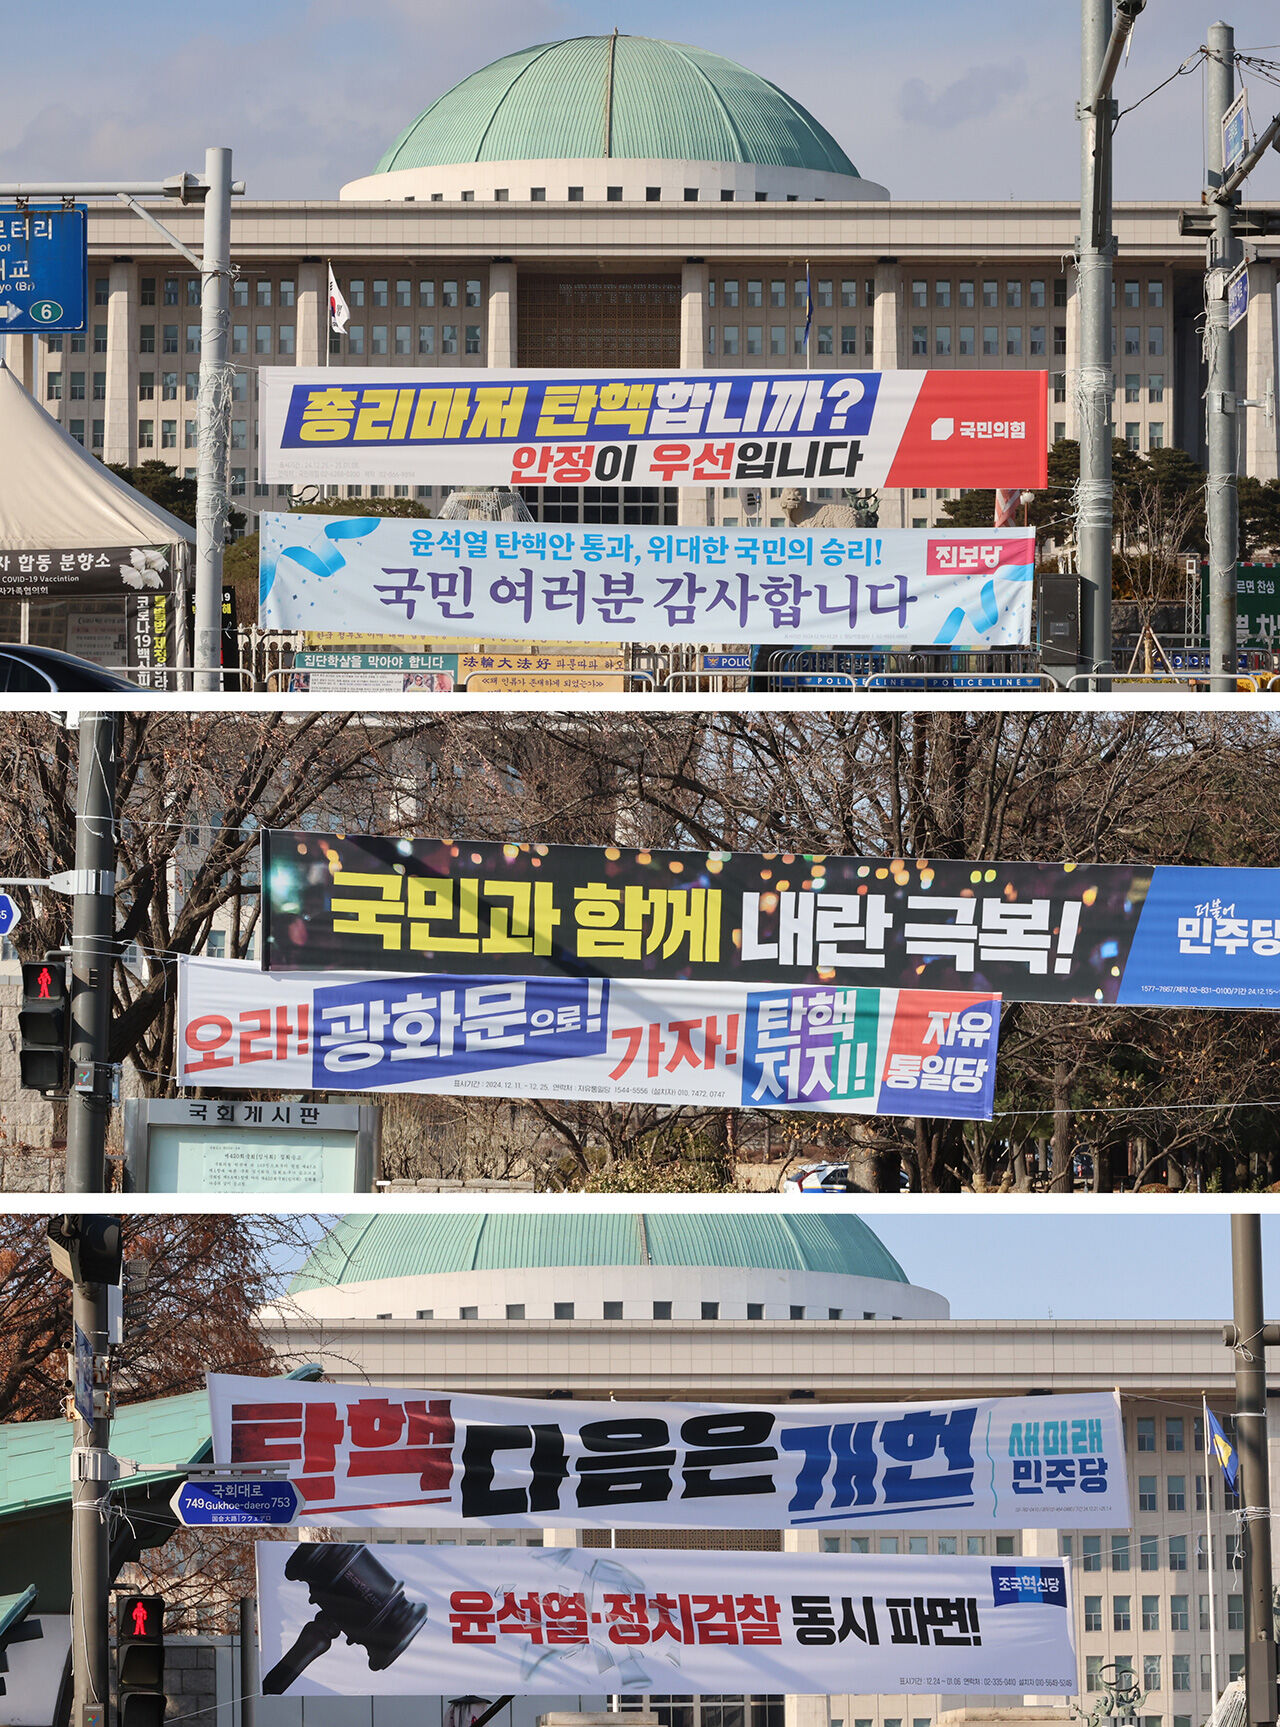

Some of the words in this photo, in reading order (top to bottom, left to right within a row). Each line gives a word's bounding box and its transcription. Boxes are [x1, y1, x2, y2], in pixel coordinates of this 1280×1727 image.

[15, 281, 36, 291] (Br)
[41, 304, 52, 320] 6
[299, 386, 529, 441] 총리마저
[535, 378, 865, 437] 탄핵합니까?
[959, 421, 1026, 439] 국민의힘
[511, 444, 638, 483] 안정이
[649, 440, 864, 481] 우선입니다
[409, 529, 488, 558] 윤석열
[495, 531, 575, 561] 탄핵안
[580, 533, 641, 566] 통과,
[647, 535, 730, 564] 위대한
[734, 537, 813, 566] 국민의
[820, 538, 882, 567] 승리!
[935, 545, 1003, 569] 진보당
[18, 554, 52, 572] 합동
[59, 553, 111, 571] 분향소
[373, 566, 474, 620] 국민
[489, 567, 644, 625] 여러분
[653, 571, 918, 629] 감사합니다
[1257, 580, 1275, 594] 찬성
[304, 655, 362, 668] 집단학살을
[368, 655, 403, 668] 막아야
[409, 655, 444, 668] 합니다
[463, 656, 552, 669] 法輪大法好
[876, 677, 905, 686] LINE
[933, 678, 983, 686] POLICE
[991, 678, 1022, 686] LINE
[1194, 898, 1235, 920] 더불어
[331, 872, 561, 956] 국민과
[574, 882, 722, 962] 함께
[741, 891, 893, 968] 내란
[904, 895, 1082, 974] 극복!
[1177, 917, 1280, 956] 민주당
[184, 1003, 310, 1074] 오라!
[320, 978, 603, 1073] 광화문으로!
[608, 1013, 740, 1081] 가자!
[757, 989, 857, 1049] 탄핵
[922, 1011, 993, 1048] 자유
[454, 1080, 480, 1088] 표시기간
[751, 1042, 868, 1102] 저지!
[886, 1053, 989, 1093] 통일당
[189, 1103, 320, 1125] 국회게시판
[1008, 1418, 1104, 1457] 새미래
[231, 1398, 456, 1501] 탄핵
[461, 1411, 779, 1518] 다음은
[780, 1407, 978, 1512] 개헌
[1012, 1457, 1108, 1494] 민주당
[212, 1484, 264, 1498] 국회대로
[185, 1498, 205, 1509] 749
[205, 1501, 271, 1511] Gukhoe-daero
[270, 1497, 291, 1508] 753
[998, 1575, 1060, 1594] 조국혁신당
[791, 1595, 880, 1646] 동시
[886, 1597, 982, 1646] 파면!
